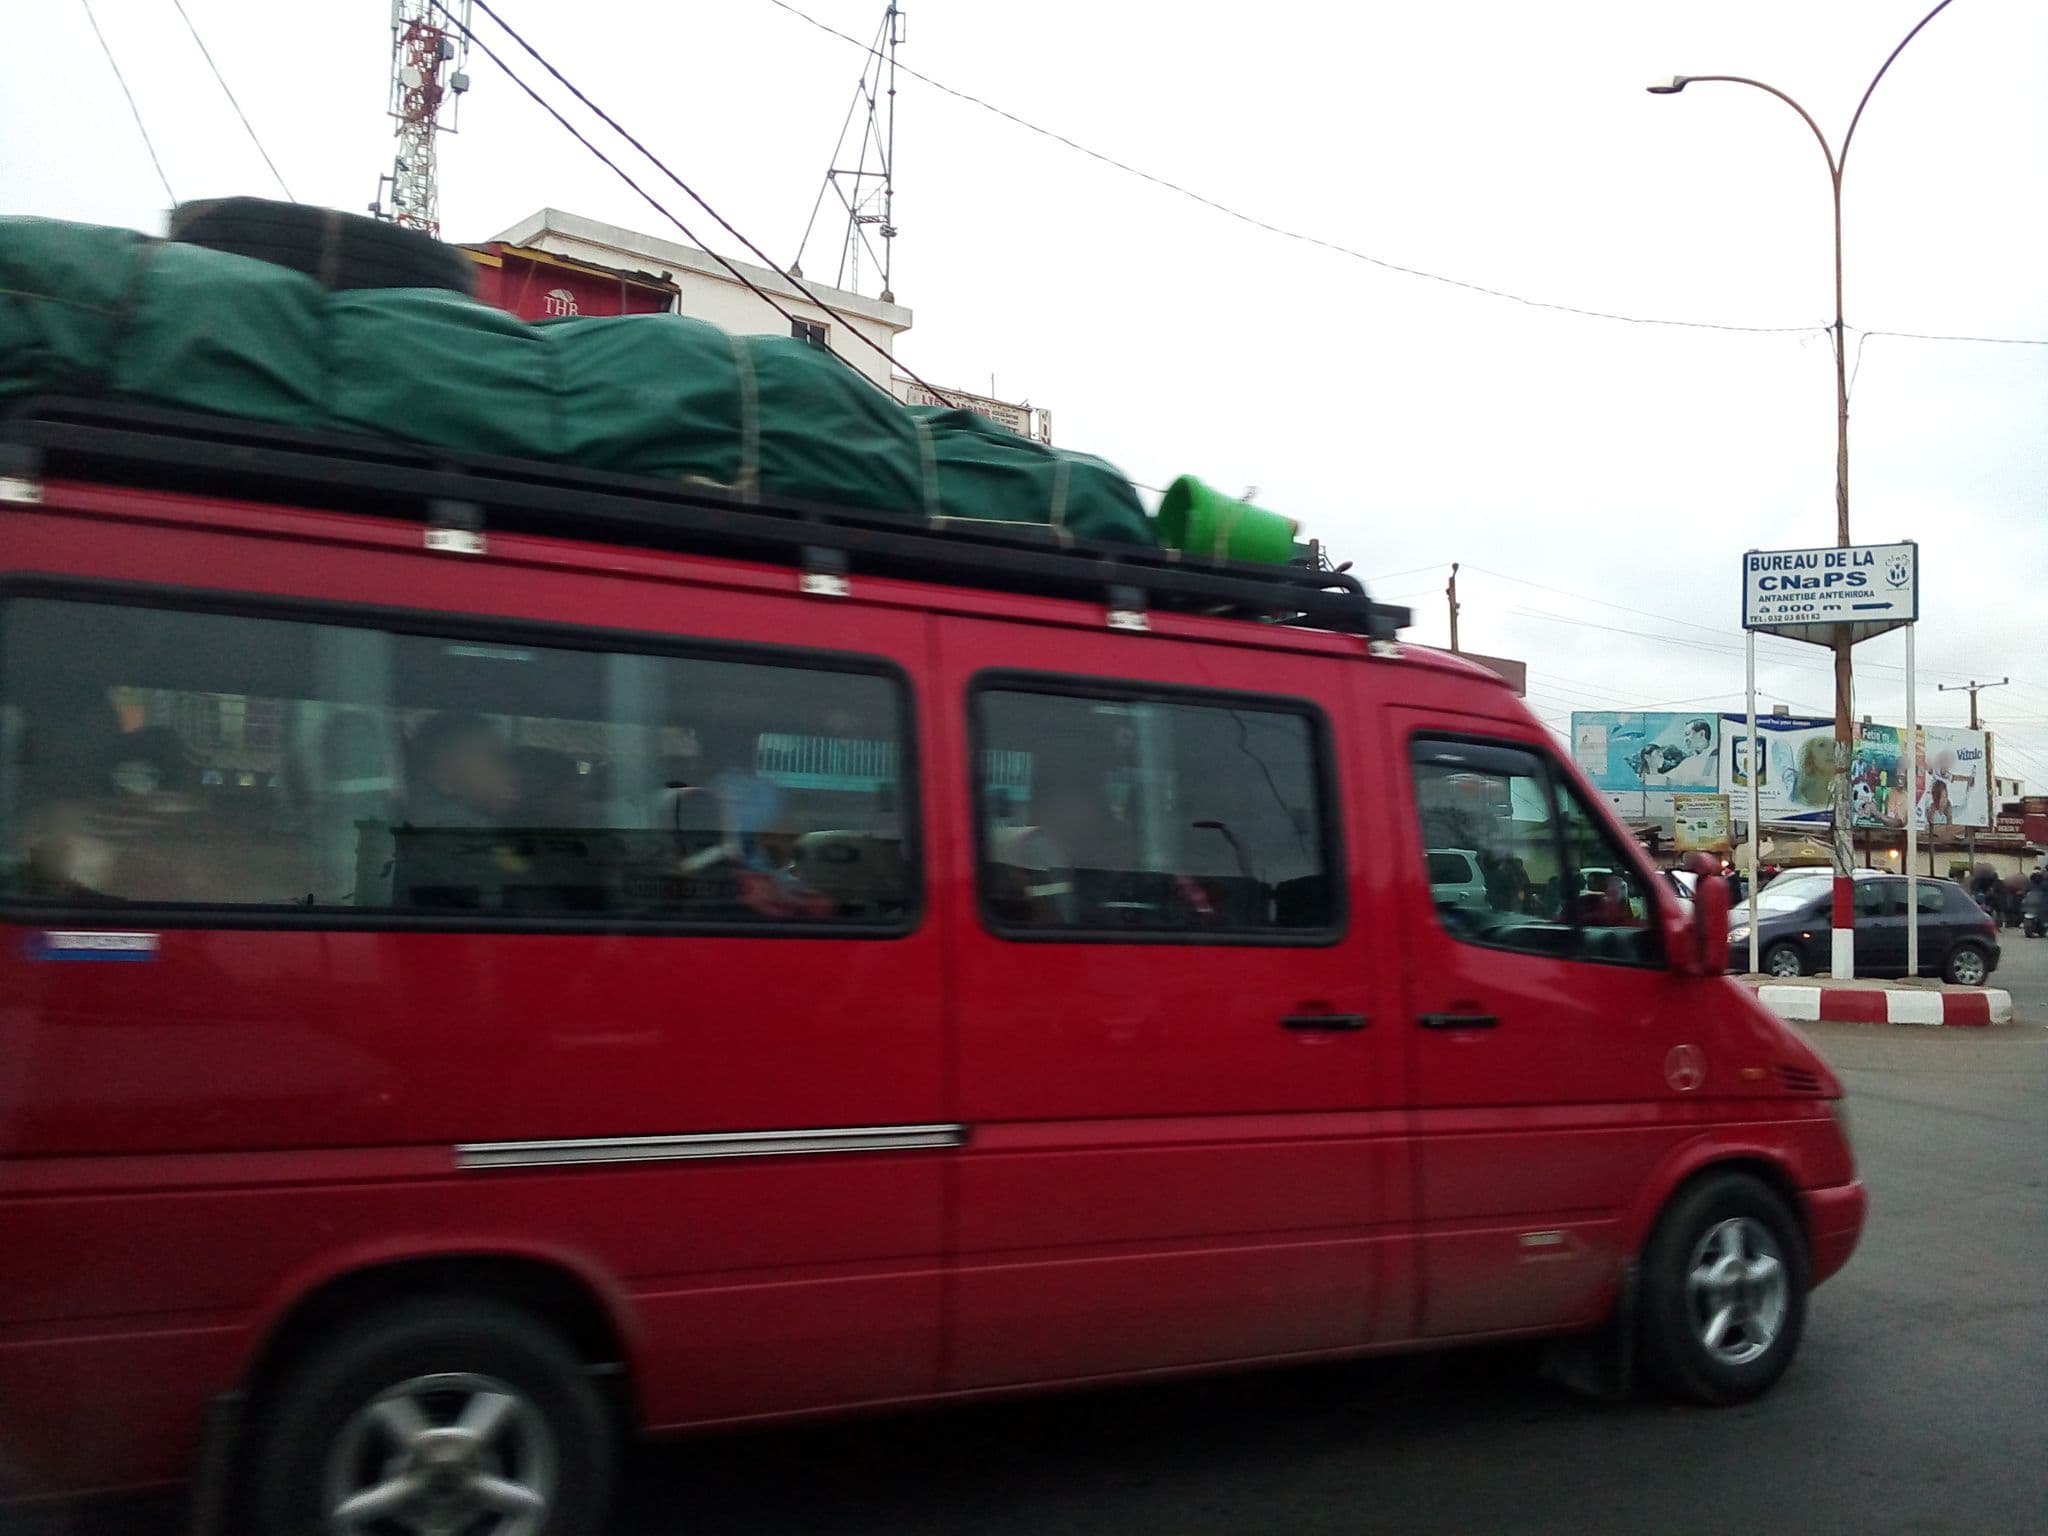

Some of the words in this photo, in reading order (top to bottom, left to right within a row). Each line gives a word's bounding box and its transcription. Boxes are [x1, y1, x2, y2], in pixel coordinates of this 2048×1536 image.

[1750, 554, 1818, 571] BUREAU
[1824, 552, 1847, 568] DE
[1853, 550, 1875, 566] LA
[1758, 571, 1868, 591] CNaPS
[1758, 592, 1816, 603] ANTANETIBE
[1819, 590, 1875, 601] ANTEHIROKA
[1777, 603, 1815, 613] 800
